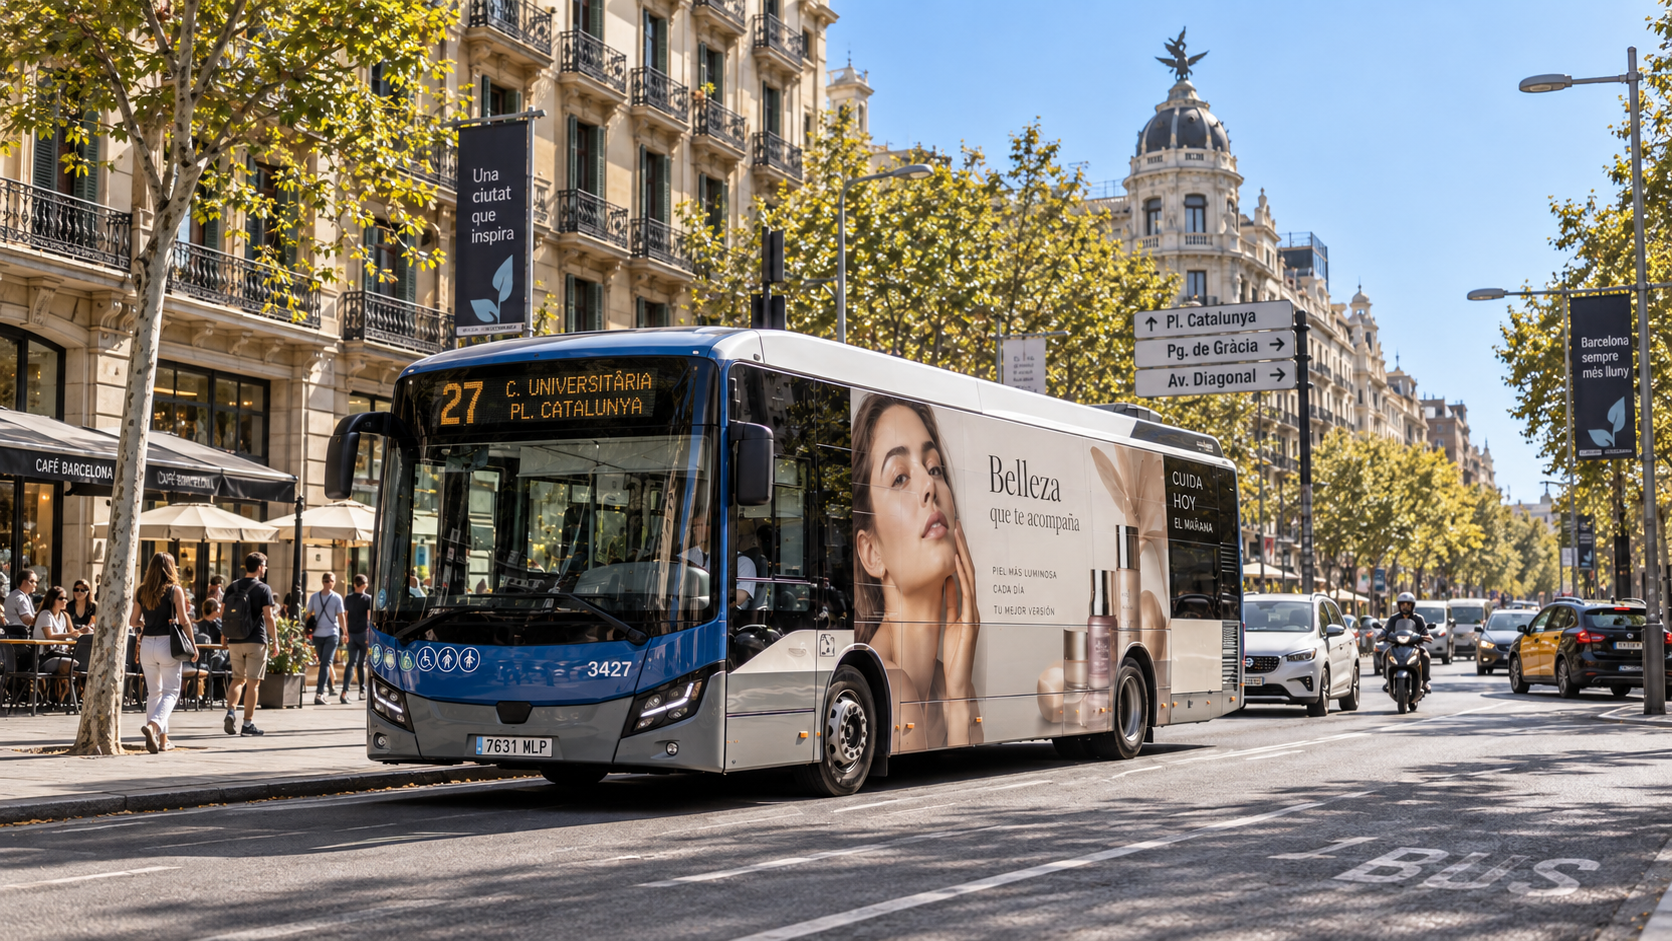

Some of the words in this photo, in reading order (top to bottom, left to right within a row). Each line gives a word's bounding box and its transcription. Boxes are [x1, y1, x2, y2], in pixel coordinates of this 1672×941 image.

[473, 168, 499, 183] Una
[472, 186, 512, 203] ciutat
[471, 210, 497, 226] que
[471, 226, 515, 245] inspira
[1166, 314, 1184, 329] Pl.
[1187, 311, 1256, 327] Catalunya
[1167, 343, 1188, 360] Pg.
[1193, 342, 1209, 356] de
[1213, 338, 1258, 355] Gràcia
[1581, 335, 1629, 348] Barcelona
[1581, 352, 1619, 364] sempre
[1168, 373, 1189, 388] Av.
[1193, 368, 1256, 388] Diagonal
[1605, 365, 1629, 379] lluny
[505, 380, 521, 398] C.
[440, 380, 484, 426] 27
[510, 403, 534, 420] PL.
[541, 397, 642, 419] CATALUNYA
[35, 458, 59, 474] CAFÉ
[62, 461, 114, 480] BARCELONA
[988, 454, 1061, 502] Belleza
[1172, 470, 1203, 490] CUIDA
[1173, 493, 1196, 511] HOY
[989, 507, 1011, 529] que
[1014, 508, 1024, 525] te
[1027, 512, 1080, 535] acompaña
[1174, 517, 1183, 529] EL
[992, 566, 1007, 576] PIEL
[1024, 569, 1057, 579] LUMINOSA
[993, 584, 1011, 594] CADA
[1013, 582, 1025, 594] DÍA
[994, 605, 1003, 615] TU
[1004, 605, 1026, 616] MEJOR
[1028, 605, 1055, 616] VERSIÓN
[587, 661, 632, 677] 3427
[486, 739, 517, 753] 7631
[522, 740, 547, 754] MLP
[1332, 847, 1601, 897] BUS
